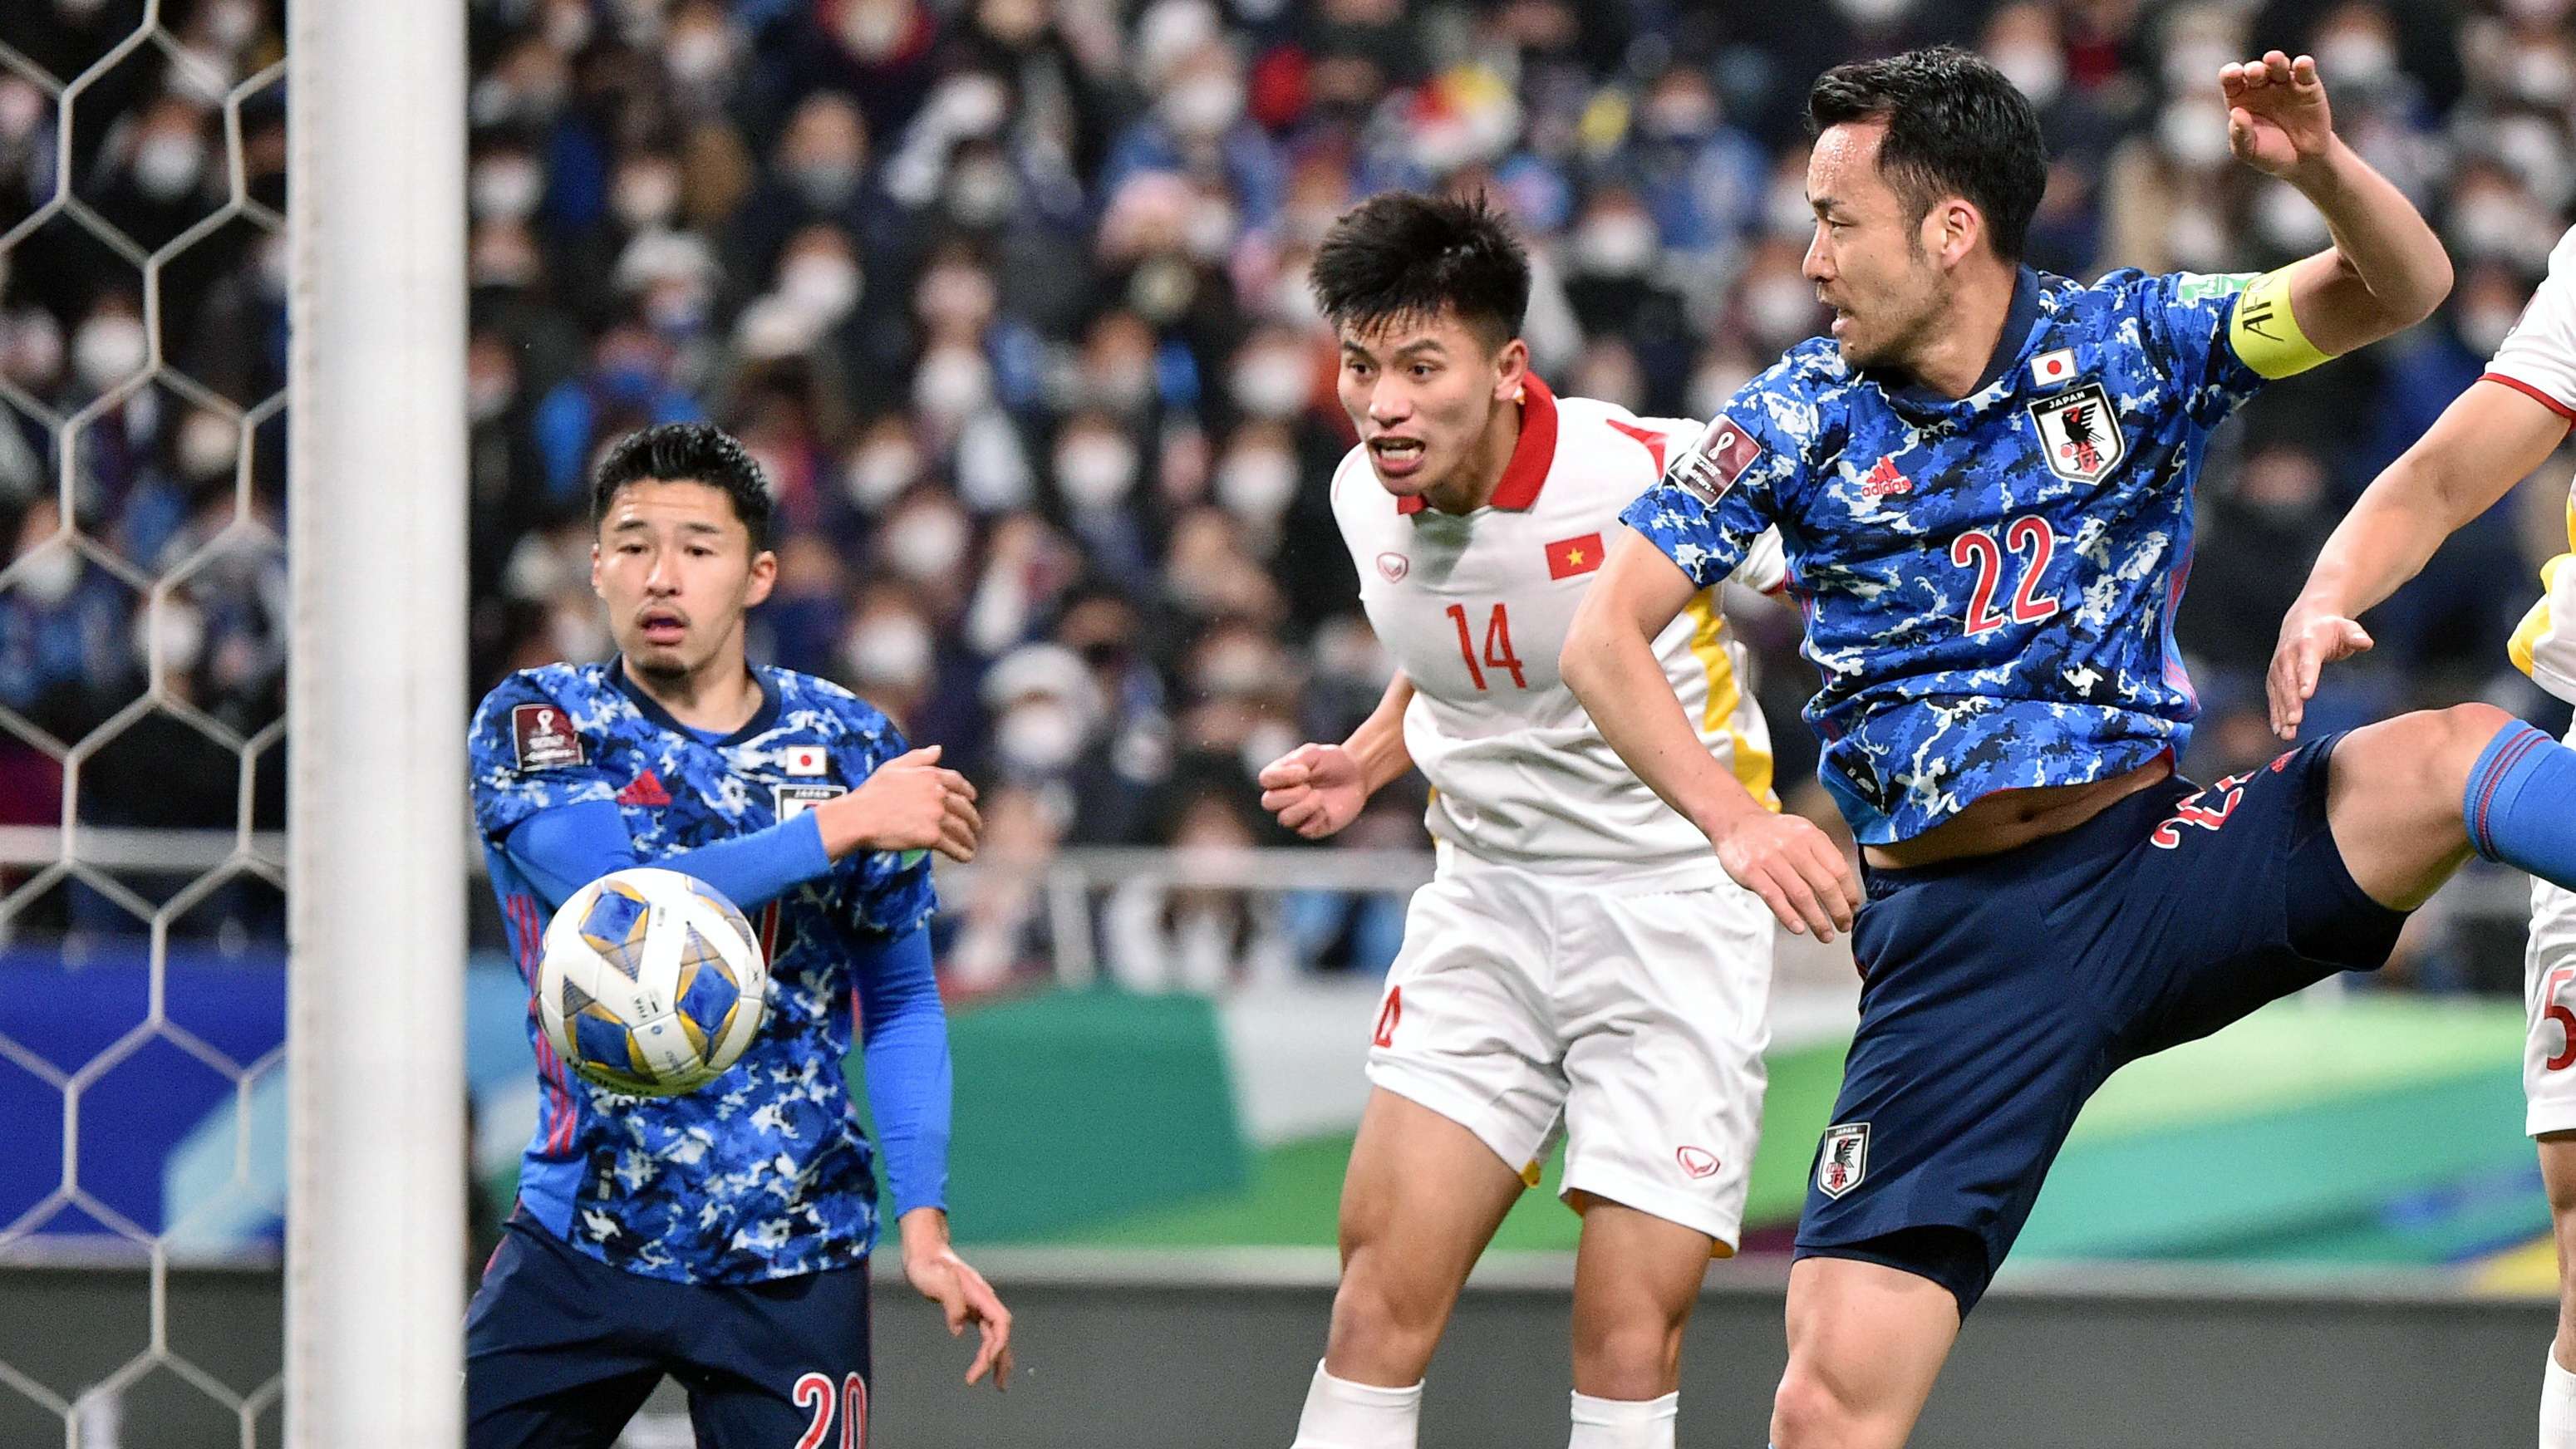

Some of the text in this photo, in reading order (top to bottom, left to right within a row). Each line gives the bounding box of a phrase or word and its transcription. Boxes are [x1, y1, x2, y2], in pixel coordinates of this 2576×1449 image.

[2048, 390, 2086, 409] JAPAN
[2074, 450, 2105, 471] JFA
[1861, 479, 1915, 497] adidas
[1950, 514, 2059, 637] 22
[1446, 604, 1526, 690] 14
[1835, 1127, 1857, 1136] JAPAN
[1827, 1172, 1848, 1185] JFA
[792, 1371, 868, 1449] 20
